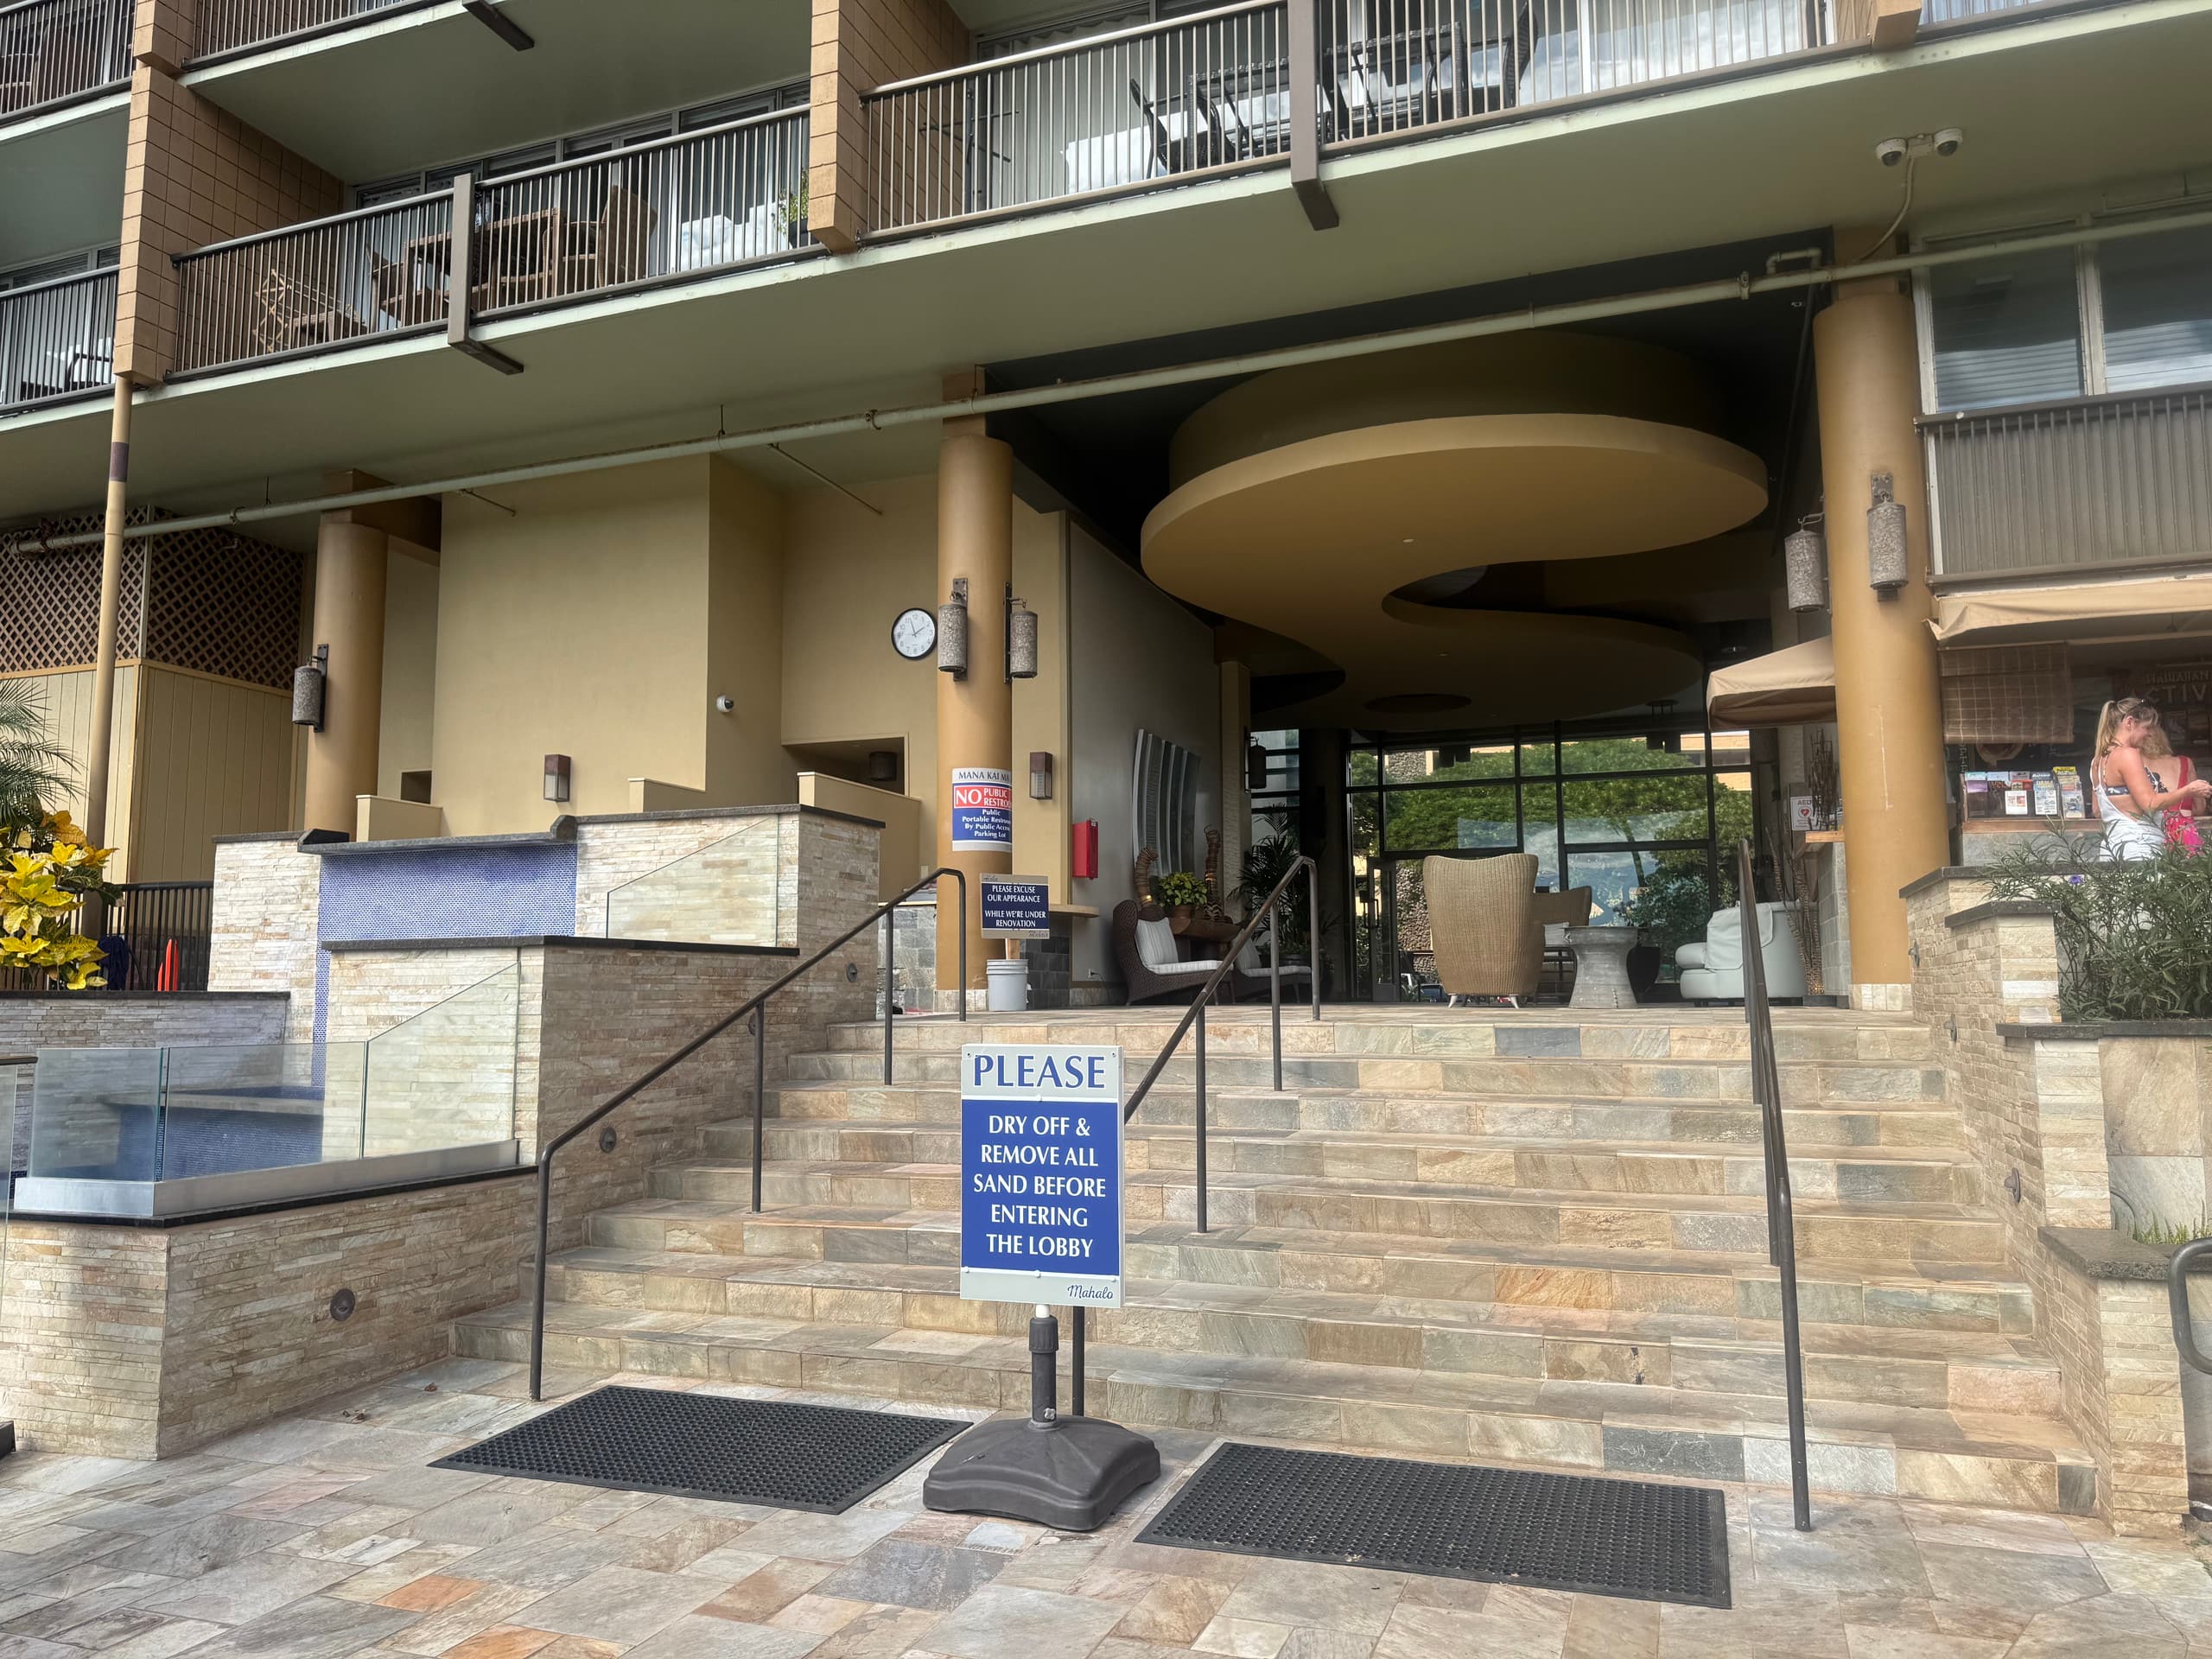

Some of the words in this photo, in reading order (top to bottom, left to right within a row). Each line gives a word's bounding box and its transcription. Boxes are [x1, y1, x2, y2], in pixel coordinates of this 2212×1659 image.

[958, 771, 985, 779] MANA
[987, 772, 1000, 780] KAI
[956, 788, 982, 805] NO
[983, 787, 1007, 798] PUBLIC
[987, 893, 1002, 902] OUR
[1002, 894, 1041, 903] APPEARANCE
[992, 884, 1013, 893] PLEASE
[973, 1053, 1106, 1089] PLEASE
[988, 1115, 1027, 1135] DRY
[1033, 1116, 1070, 1136] OFF
[1076, 1117, 1090, 1136] &
[981, 1144, 1059, 1166] REMOVE
[1065, 1147, 1098, 1167] ALL
[974, 1173, 1027, 1194] SAND
[1033, 1176, 1106, 1198] BEFORE
[991, 1204, 1088, 1227] ENTERING
[986, 1233, 1023, 1255] THE
[1029, 1236, 1093, 1258] LOBBY
[1067, 1284, 1114, 1300] Mahalo
